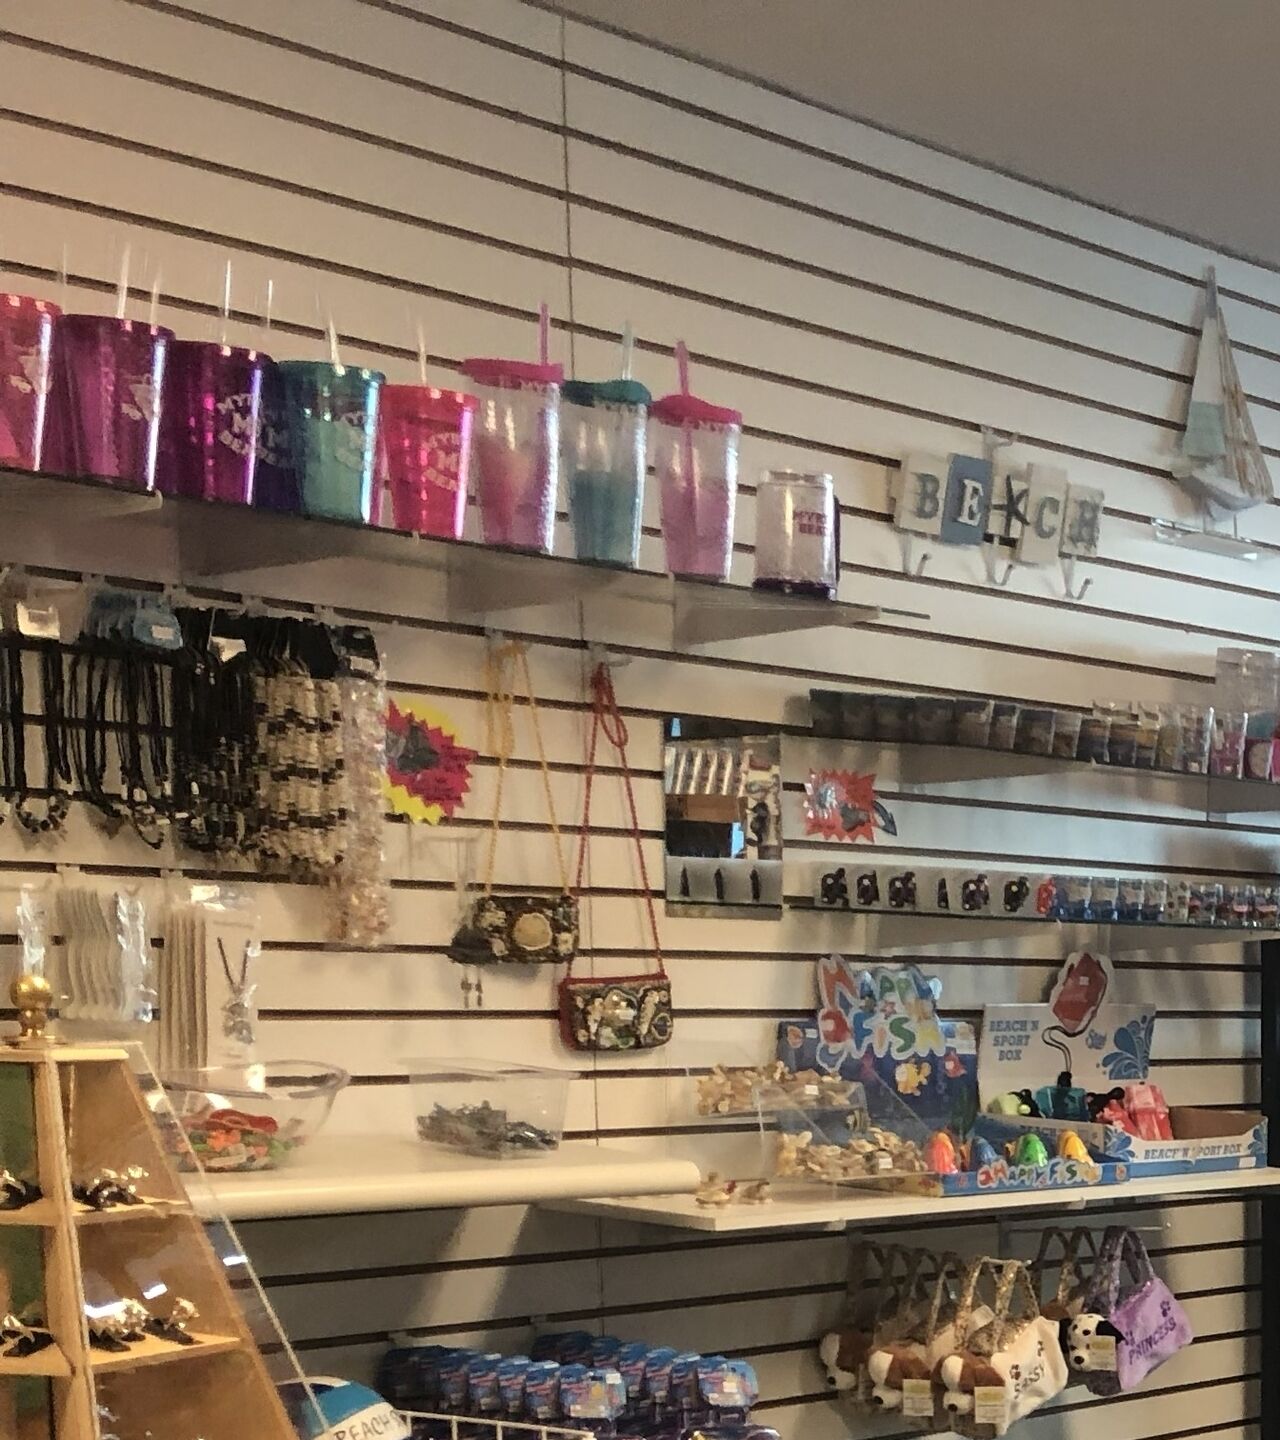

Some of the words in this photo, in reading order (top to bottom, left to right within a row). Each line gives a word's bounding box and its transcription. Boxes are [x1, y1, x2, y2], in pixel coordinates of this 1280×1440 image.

[911, 472, 1101, 550] BECH
[989, 1020, 1027, 1032] BEACH
[993, 1035, 1030, 1047] SPORT
[998, 1049, 1022, 1061] BOX
